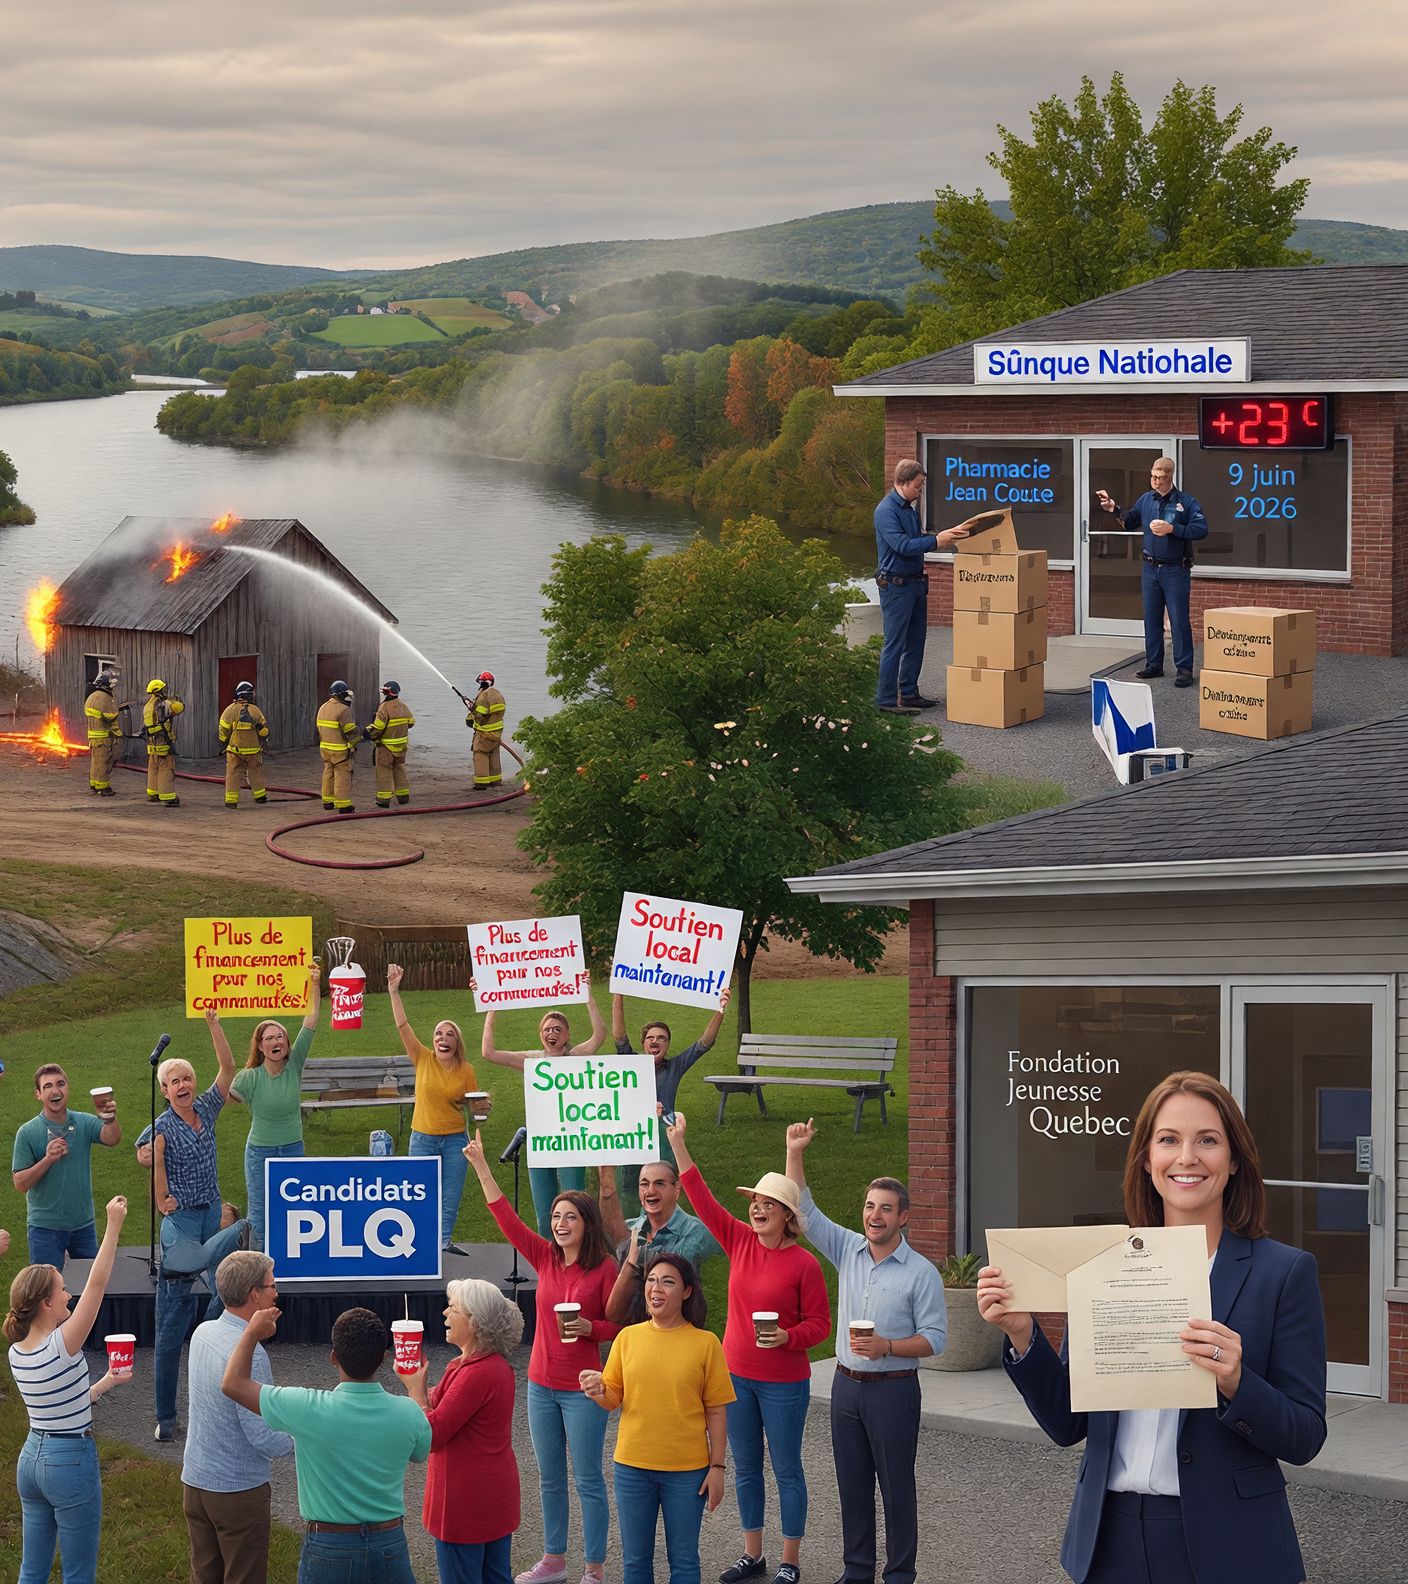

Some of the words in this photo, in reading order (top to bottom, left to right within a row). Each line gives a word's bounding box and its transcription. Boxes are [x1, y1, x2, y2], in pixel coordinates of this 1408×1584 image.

[988, 350, 1090, 381] Sûnque
[945, 457, 1051, 479] Pharmacie
[1228, 463, 1243, 486] 9
[1250, 463, 1296, 492] juin
[945, 481, 987, 501] Jean
[1234, 496, 1297, 519] 2026
[212, 921, 253, 946] Plus
[260, 921, 283, 944] de
[487, 924, 522, 946] Plus
[528, 921, 549, 942] de
[630, 899, 723, 941] Soutien
[645, 930, 701, 965] local
[256, 972, 284, 986] nos
[534, 965, 563, 978] nos
[1008, 1049, 1120, 1074] Fondation
[532, 1061, 638, 1091] Soutien
[1005, 1077, 1102, 1106] Jeunesse
[558, 1090, 620, 1122] local
[1029, 1105, 1131, 1139] Quebec
[279, 1176, 427, 1202] Candidats
[286, 1207, 417, 1259] PLQ
